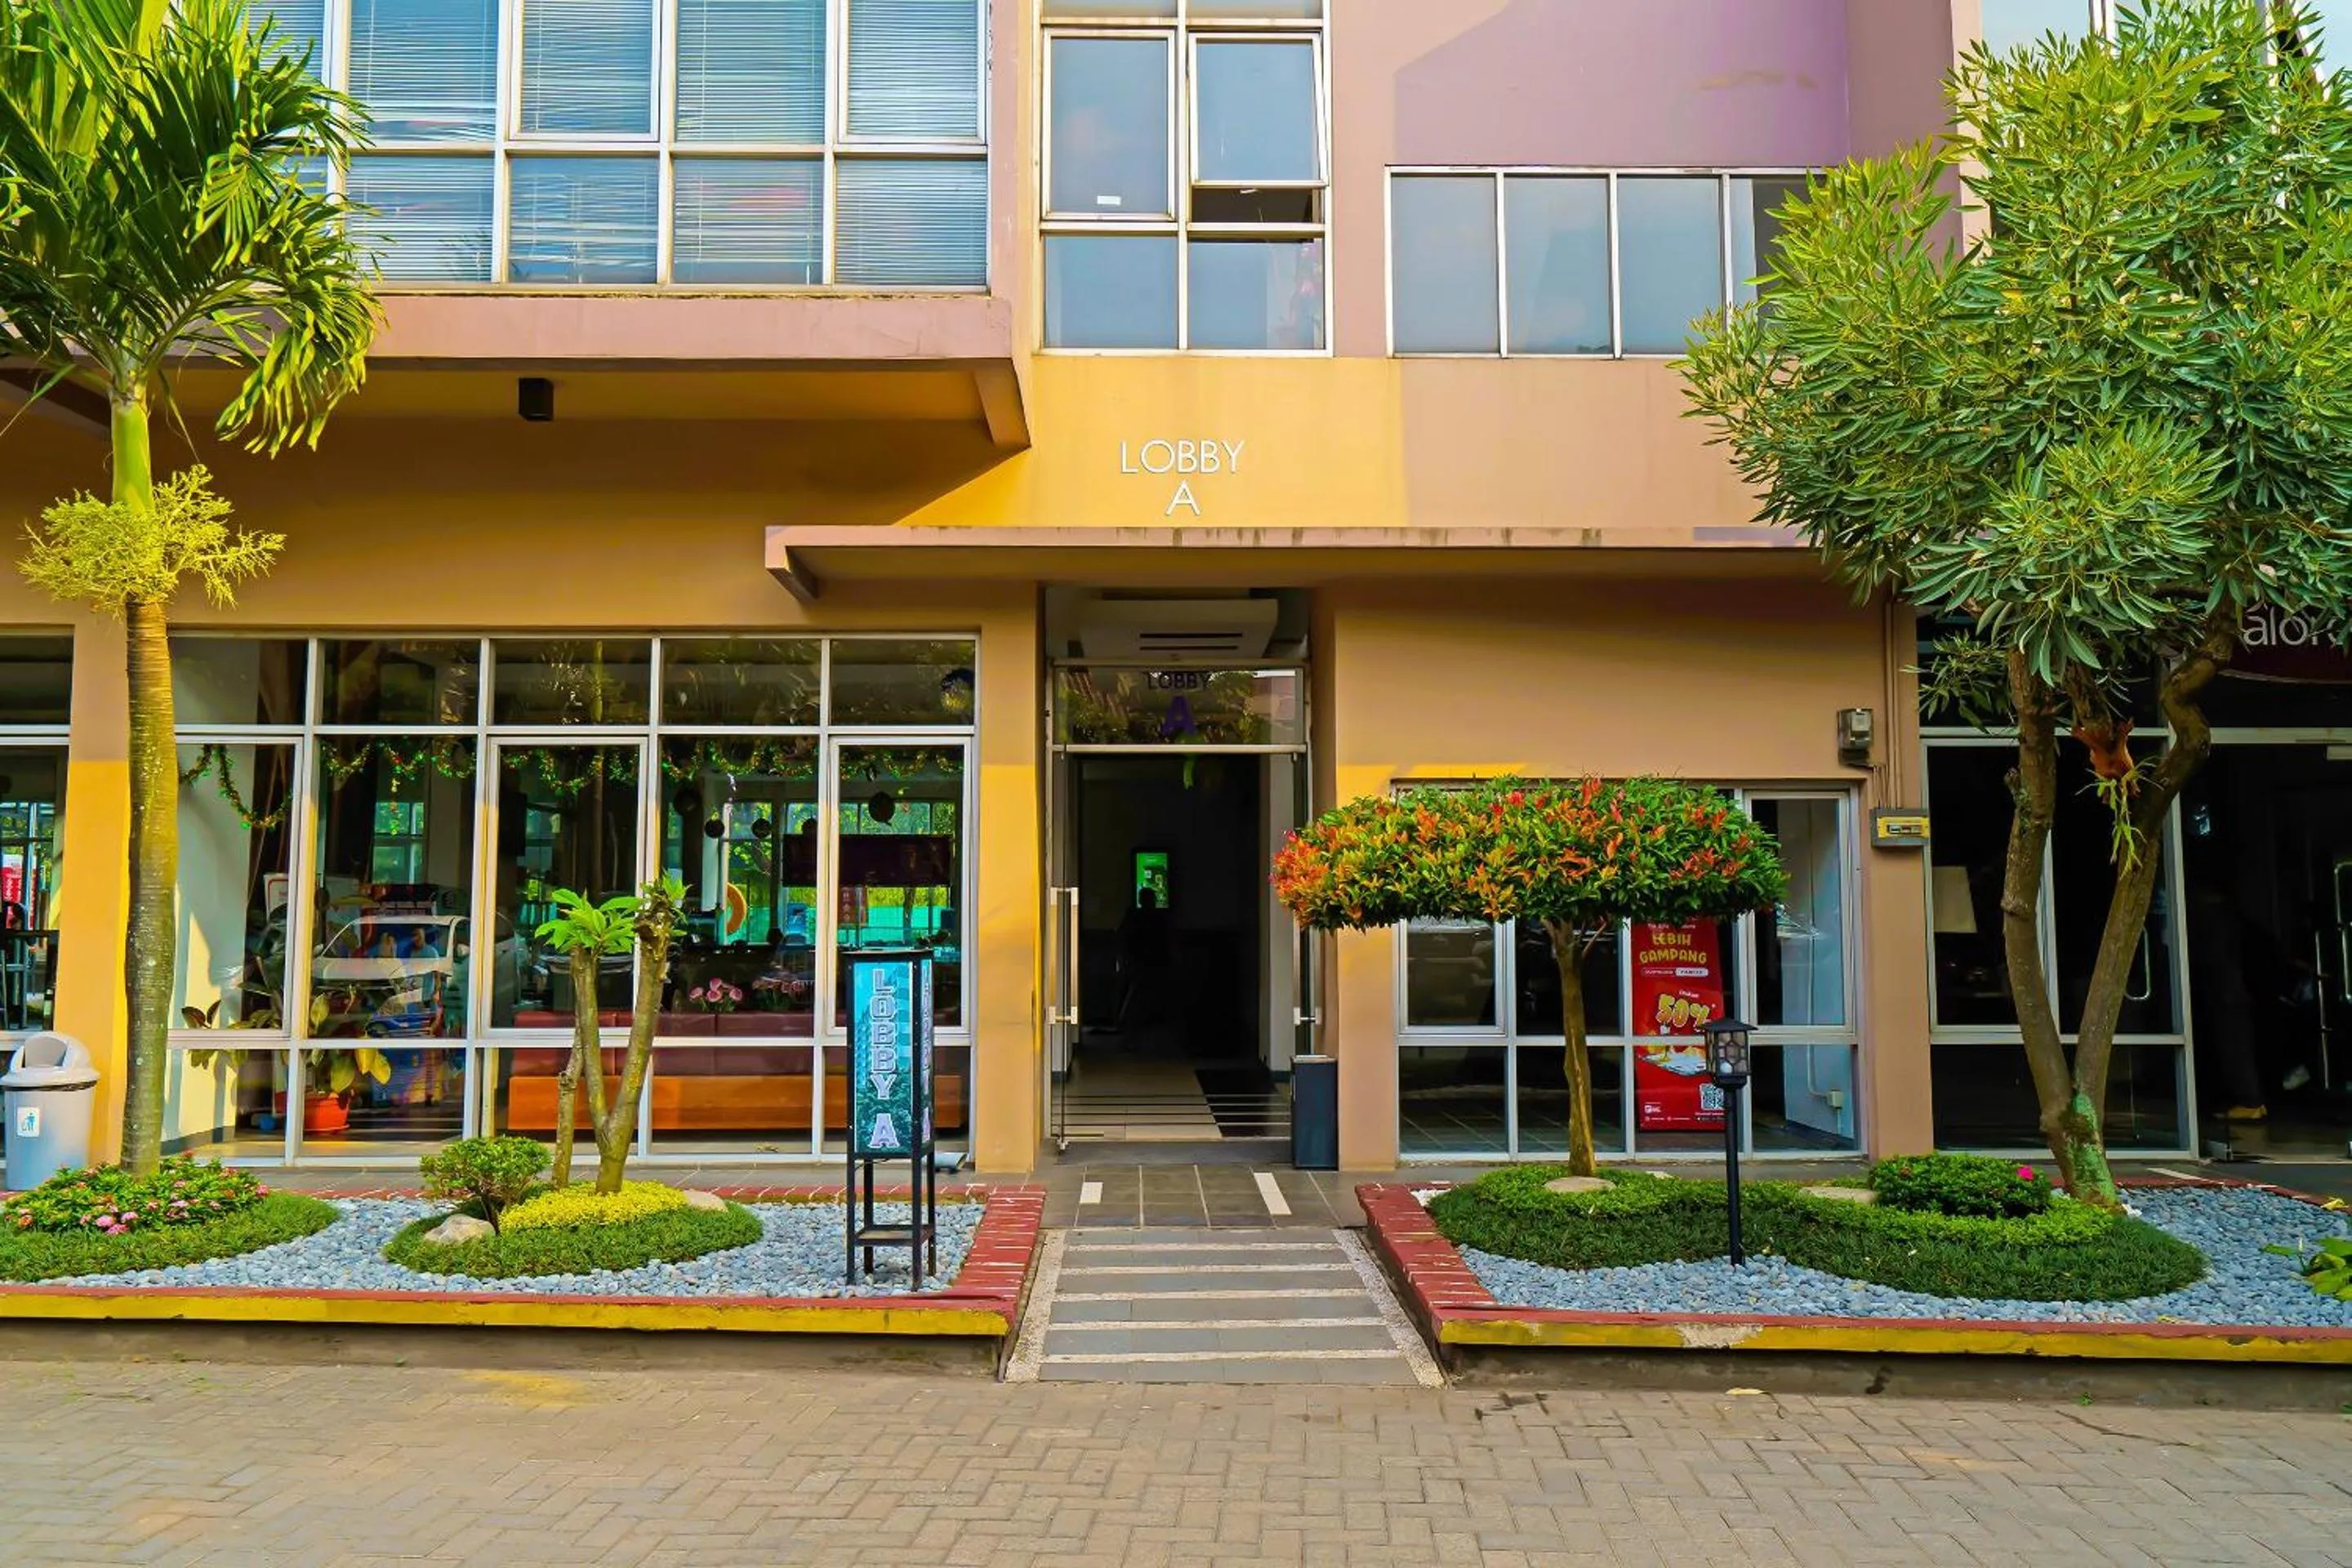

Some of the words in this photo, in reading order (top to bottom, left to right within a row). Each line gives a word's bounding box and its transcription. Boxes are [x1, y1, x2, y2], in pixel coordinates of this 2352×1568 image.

[1120, 439, 1244, 473] LOBBY
[1165, 479, 1200, 515] A
[1147, 670, 1211, 690] LOBBY
[1161, 696, 1197, 737] A
[1639, 948, 1707, 964] GAMPANG
[1652, 933, 1691, 946] LEBIH
[870, 969, 898, 1099] LOBBY
[869, 1113, 900, 1148] A
